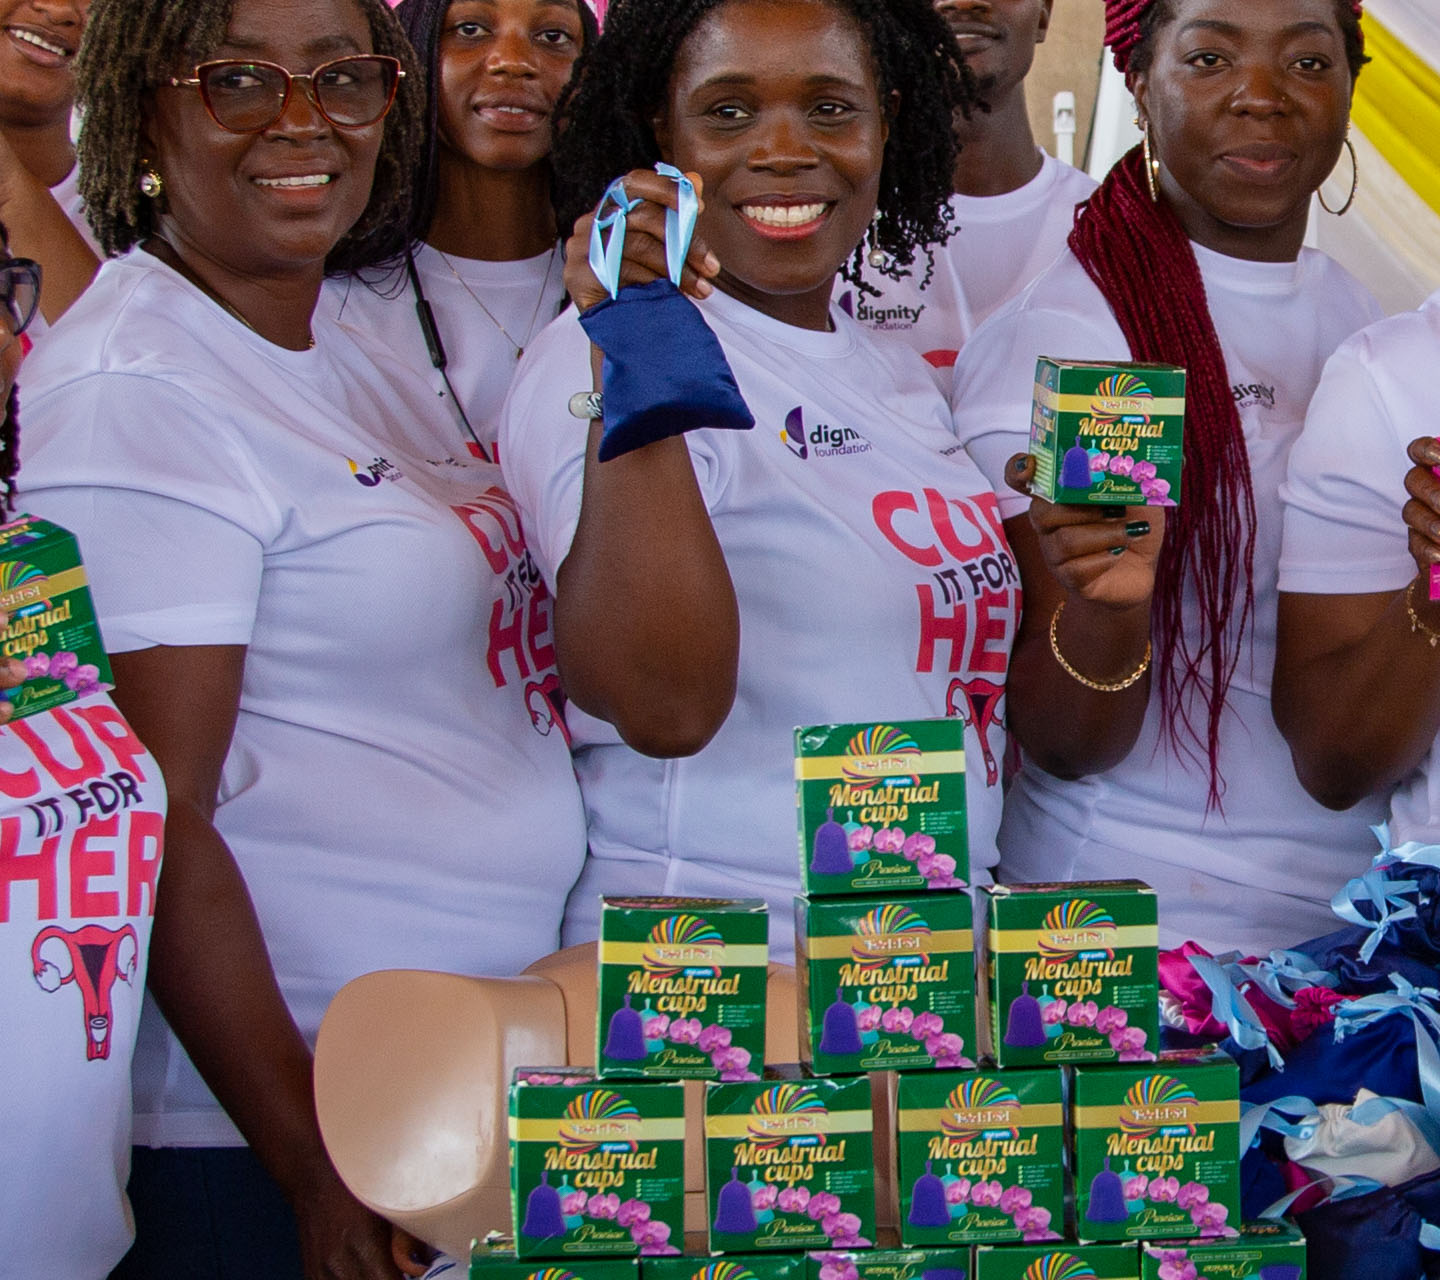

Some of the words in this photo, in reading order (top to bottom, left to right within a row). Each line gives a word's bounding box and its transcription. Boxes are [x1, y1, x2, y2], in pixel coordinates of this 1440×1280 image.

[1079, 418, 1164, 438] Menstrual
[1100, 436, 1139, 456] cups
[934, 569, 962, 604] IT
[963, 552, 1017, 595] FOR
[487, 581, 556, 688] HE
[915, 584, 1023, 672] HE
[3, 629, 49, 656] cups
[26, 797, 63, 837] IT
[66, 771, 143, 823] FOR
[829, 781, 940, 807] Menstrual
[859, 802, 909, 828] cups
[627, 969, 740, 996] Menstrual
[839, 960, 949, 987] Menstrual
[657, 993, 707, 1018] cups
[869, 983, 918, 1007] cups
[928, 1133, 1038, 1160] Menstrual
[958, 1156, 1007, 1181] cups
